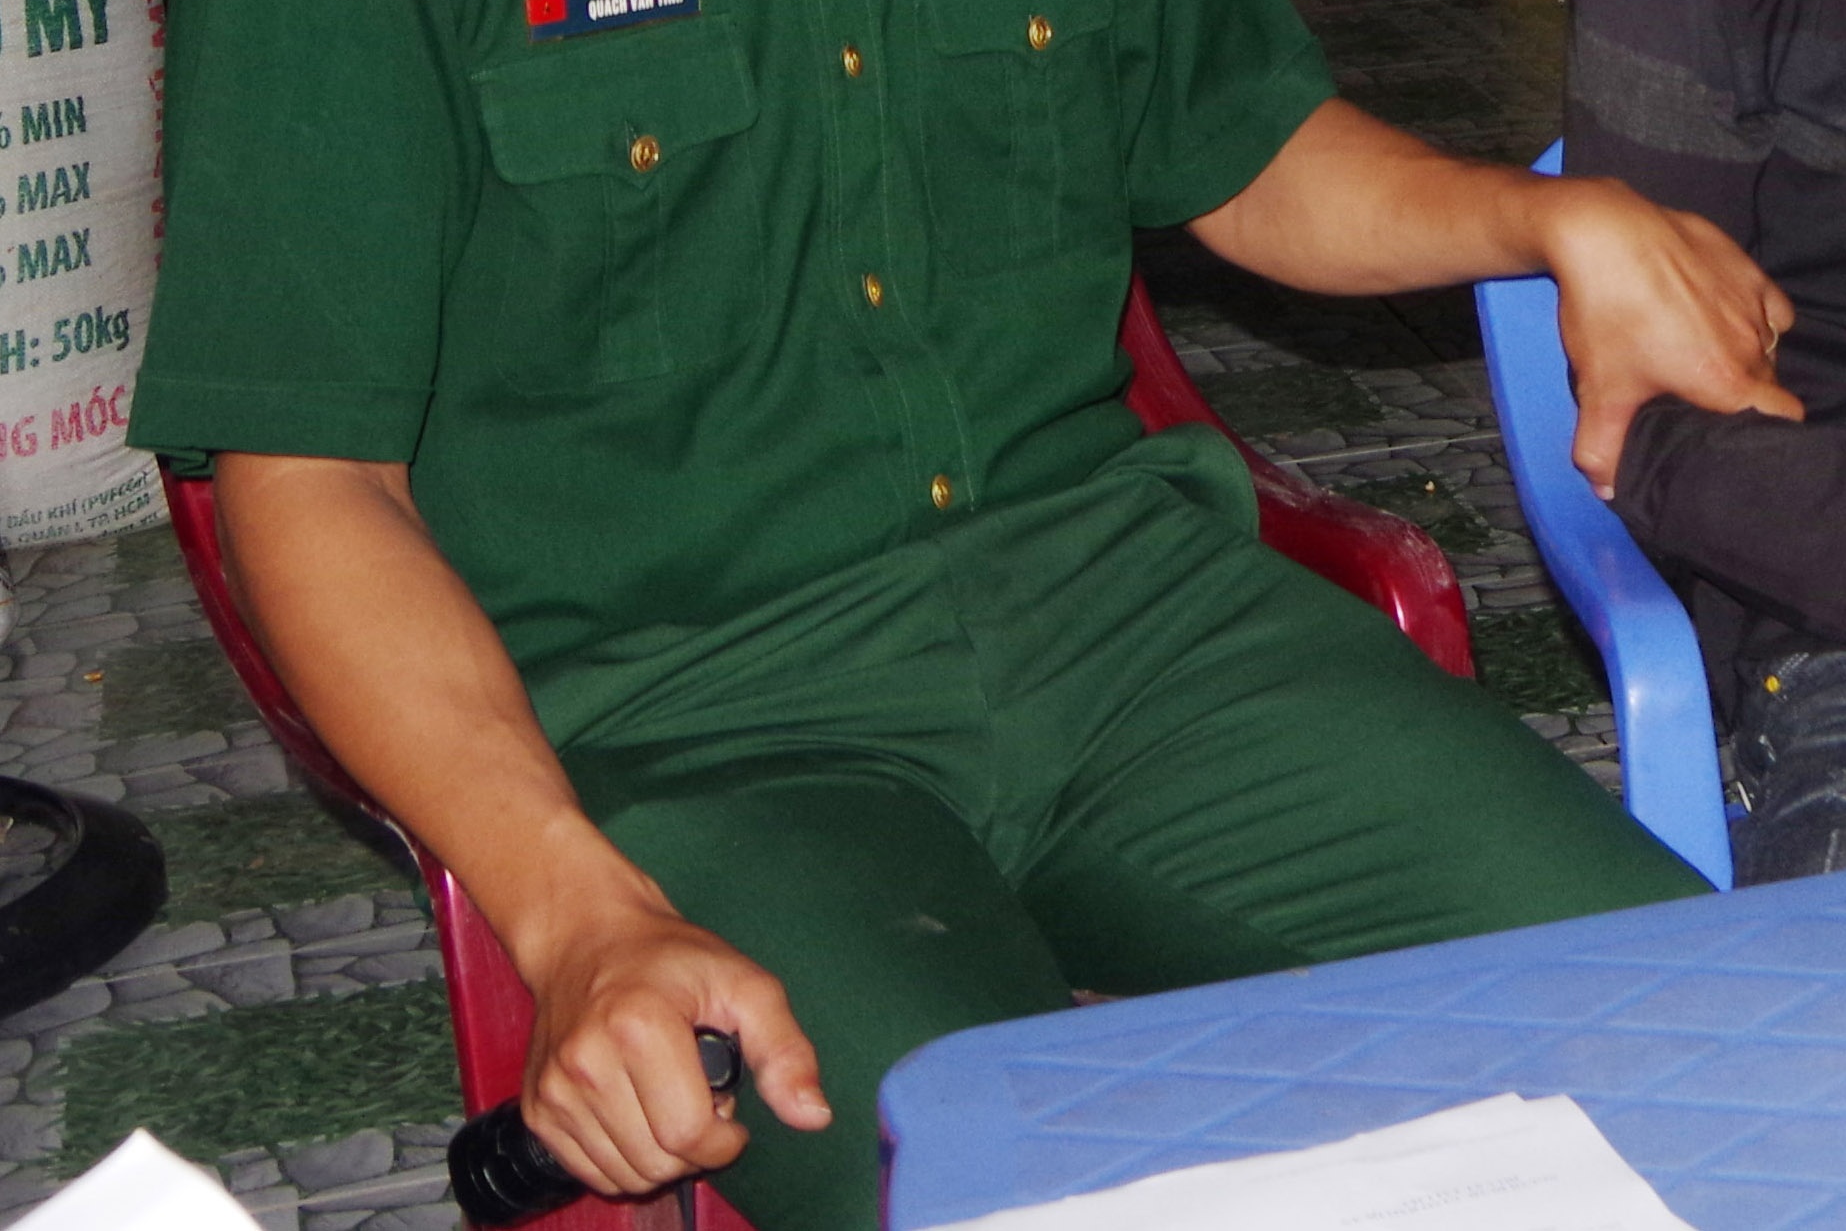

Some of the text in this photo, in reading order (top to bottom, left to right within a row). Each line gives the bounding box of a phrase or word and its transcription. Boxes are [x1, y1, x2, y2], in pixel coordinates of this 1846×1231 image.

[21, 96, 87, 144] MIN
[17, 161, 90, 214] MAX
[17, 228, 91, 284] MAX
[52, 305, 129, 362] 50kg
[51, 384, 128, 450] MÓC
